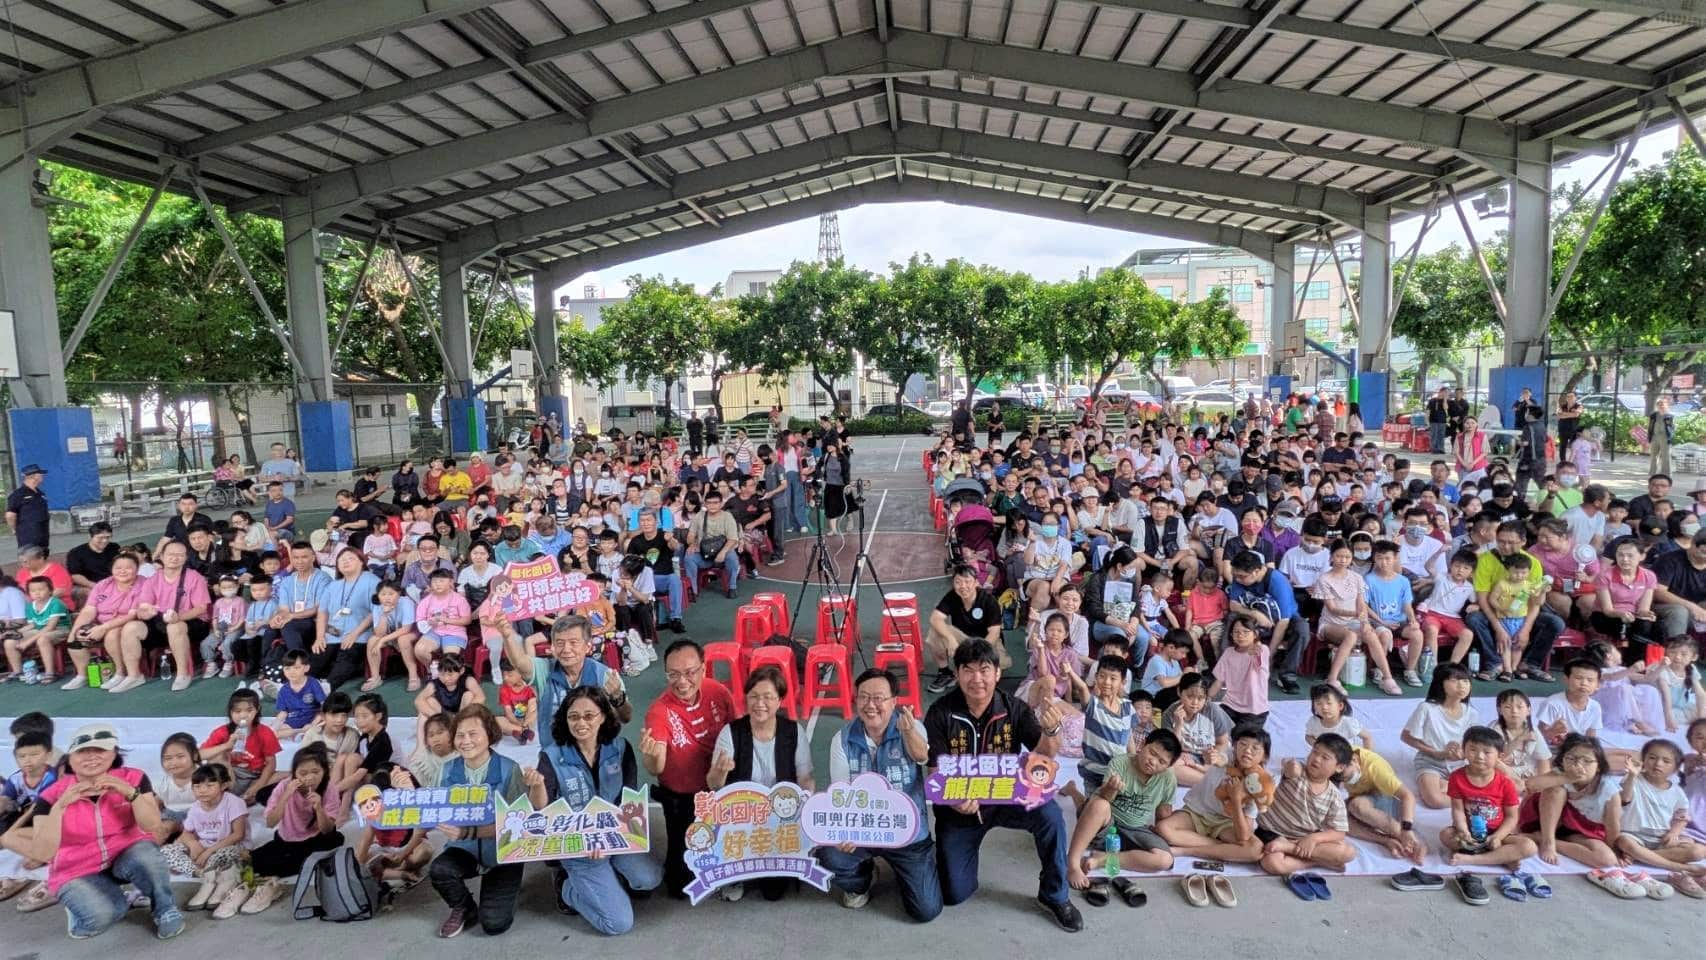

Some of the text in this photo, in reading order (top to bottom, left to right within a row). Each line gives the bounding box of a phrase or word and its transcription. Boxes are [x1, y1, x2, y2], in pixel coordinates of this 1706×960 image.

[511, 562, 553, 579] 彰化囡仔
[517, 574, 581, 599] 引領未來
[527, 586, 592, 613] 共創美好
[936, 754, 1020, 776] 彰化囡仔
[943, 777, 1016, 800] 熊厲害
[381, 807, 486, 827] 成長築夢未來
[694, 791, 771, 825] 彰化囡仔
[551, 811, 620, 833] 彰化縣
[812, 811, 908, 830] 阿兜仔遊台灣
[518, 831, 630, 857] 兒童節活動
[722, 823, 801, 859] 好幸福
